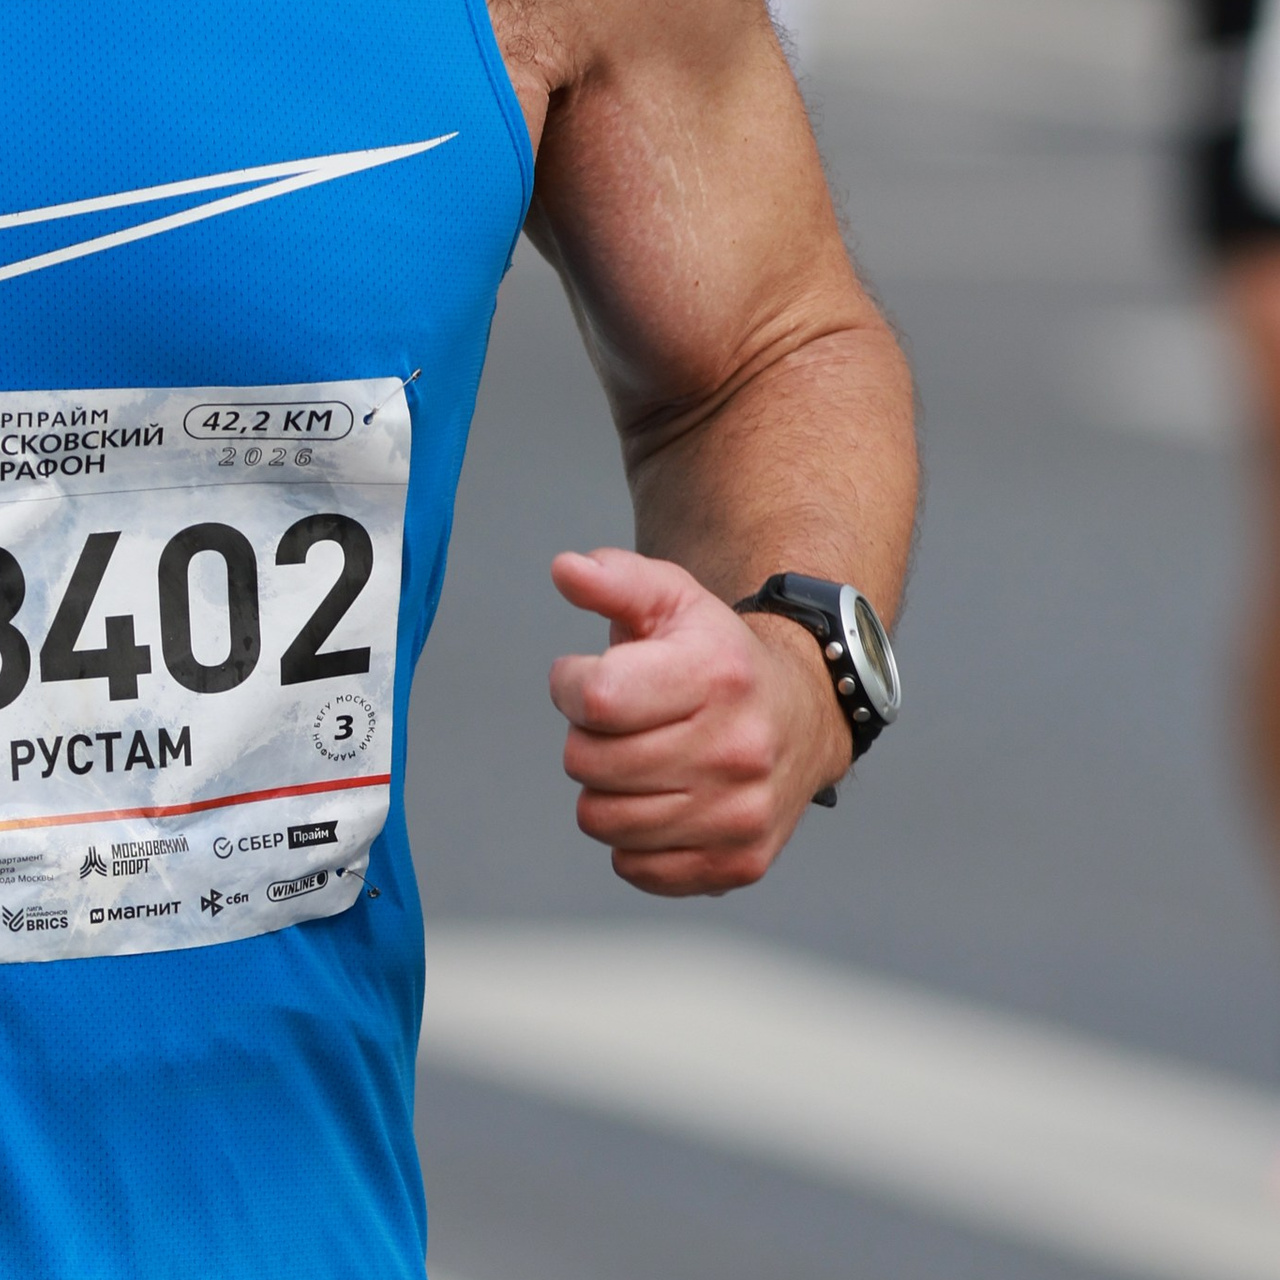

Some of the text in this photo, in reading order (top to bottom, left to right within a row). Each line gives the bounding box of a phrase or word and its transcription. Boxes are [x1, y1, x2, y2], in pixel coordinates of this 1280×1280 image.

[202, 411, 270, 434] 42,2
[218, 447, 313, 466] 2026
[313, 694, 377, 761] БЕГУ МОСКОВСКИЙ МАРАФОН
[334, 715, 354, 740] 3
[9, 726, 192, 782] РУСТАМ
[111, 834, 189, 859] МОСКОВСКИЙ
[238, 827, 330, 852] СБЕР Прайм
[112, 858, 150, 877] СПОРТ
[18, 875, 54, 883] Москвы
[272, 876, 316, 898] WINLINE
[226, 893, 249, 906] сбп
[26, 916, 69, 931] BRICS
